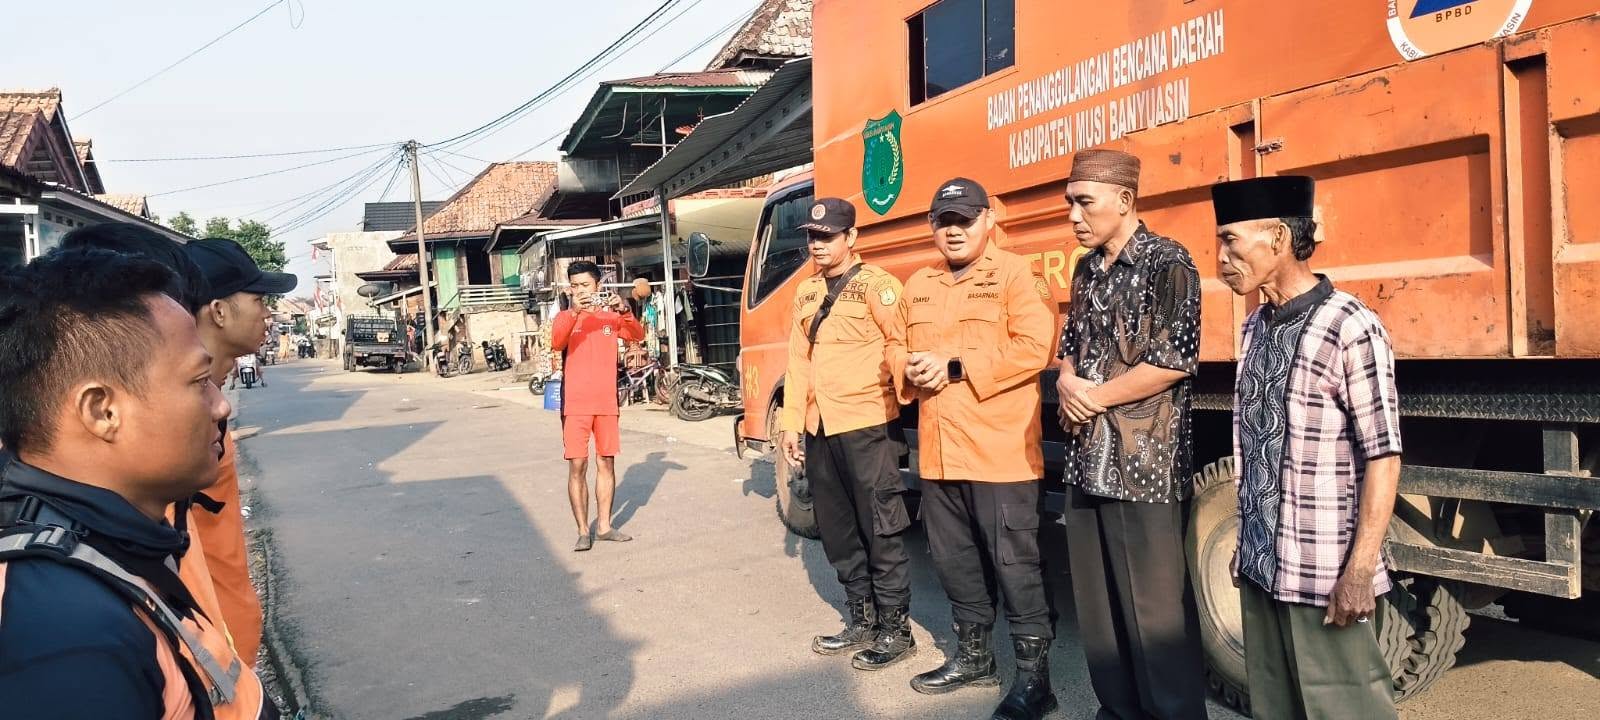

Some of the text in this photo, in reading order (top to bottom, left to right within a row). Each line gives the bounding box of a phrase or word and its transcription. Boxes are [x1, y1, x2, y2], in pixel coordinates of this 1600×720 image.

[1435, 5, 1472, 23] BPBD
[987, 9, 1224, 130] BADAN PENANGGULANGAN BENCANA DAERAH
[1009, 78, 1190, 169] KABUPATEN MUSI BANYUASIN
